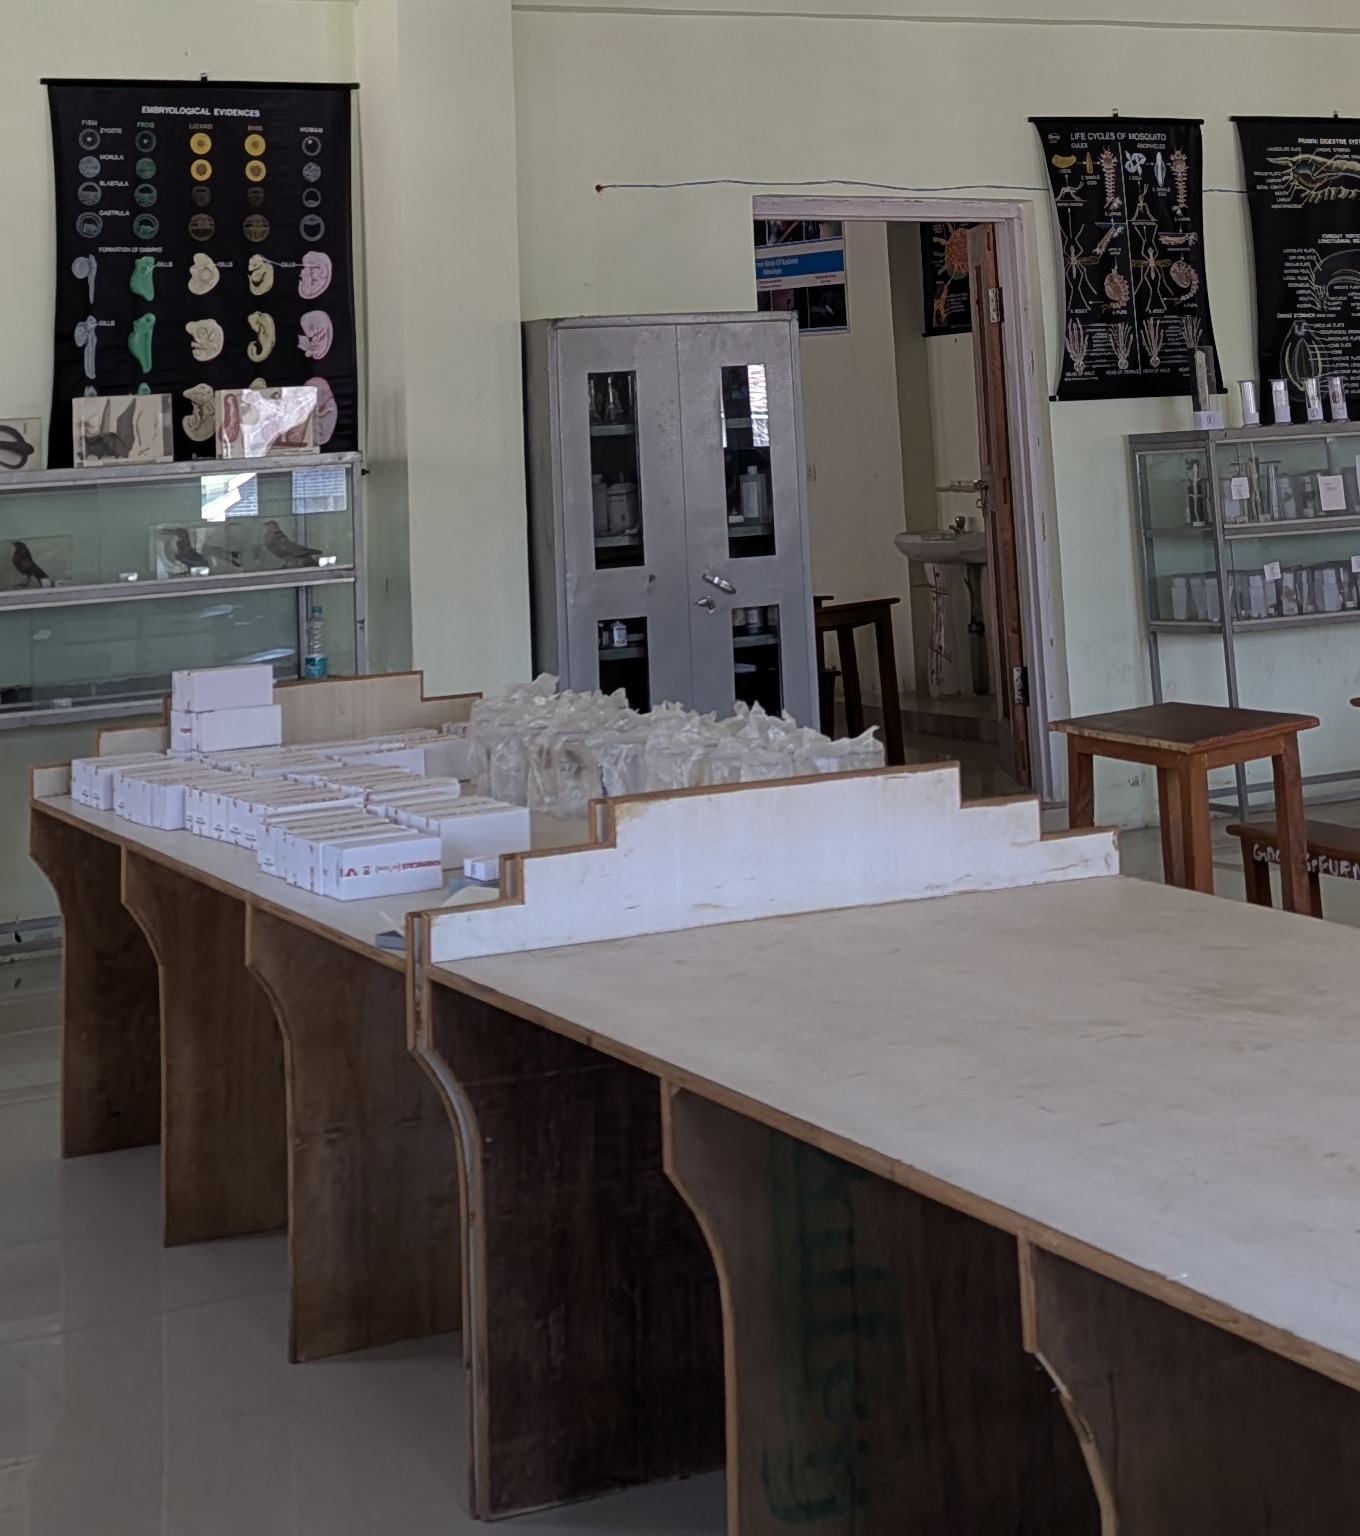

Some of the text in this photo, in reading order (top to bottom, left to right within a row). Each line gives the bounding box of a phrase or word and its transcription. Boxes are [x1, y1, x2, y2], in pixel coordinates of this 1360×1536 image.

[142, 106, 260, 117] EMBRYOLOGICAL EVIDENCES
[1128, 133, 1166, 141] MOSQUITO
